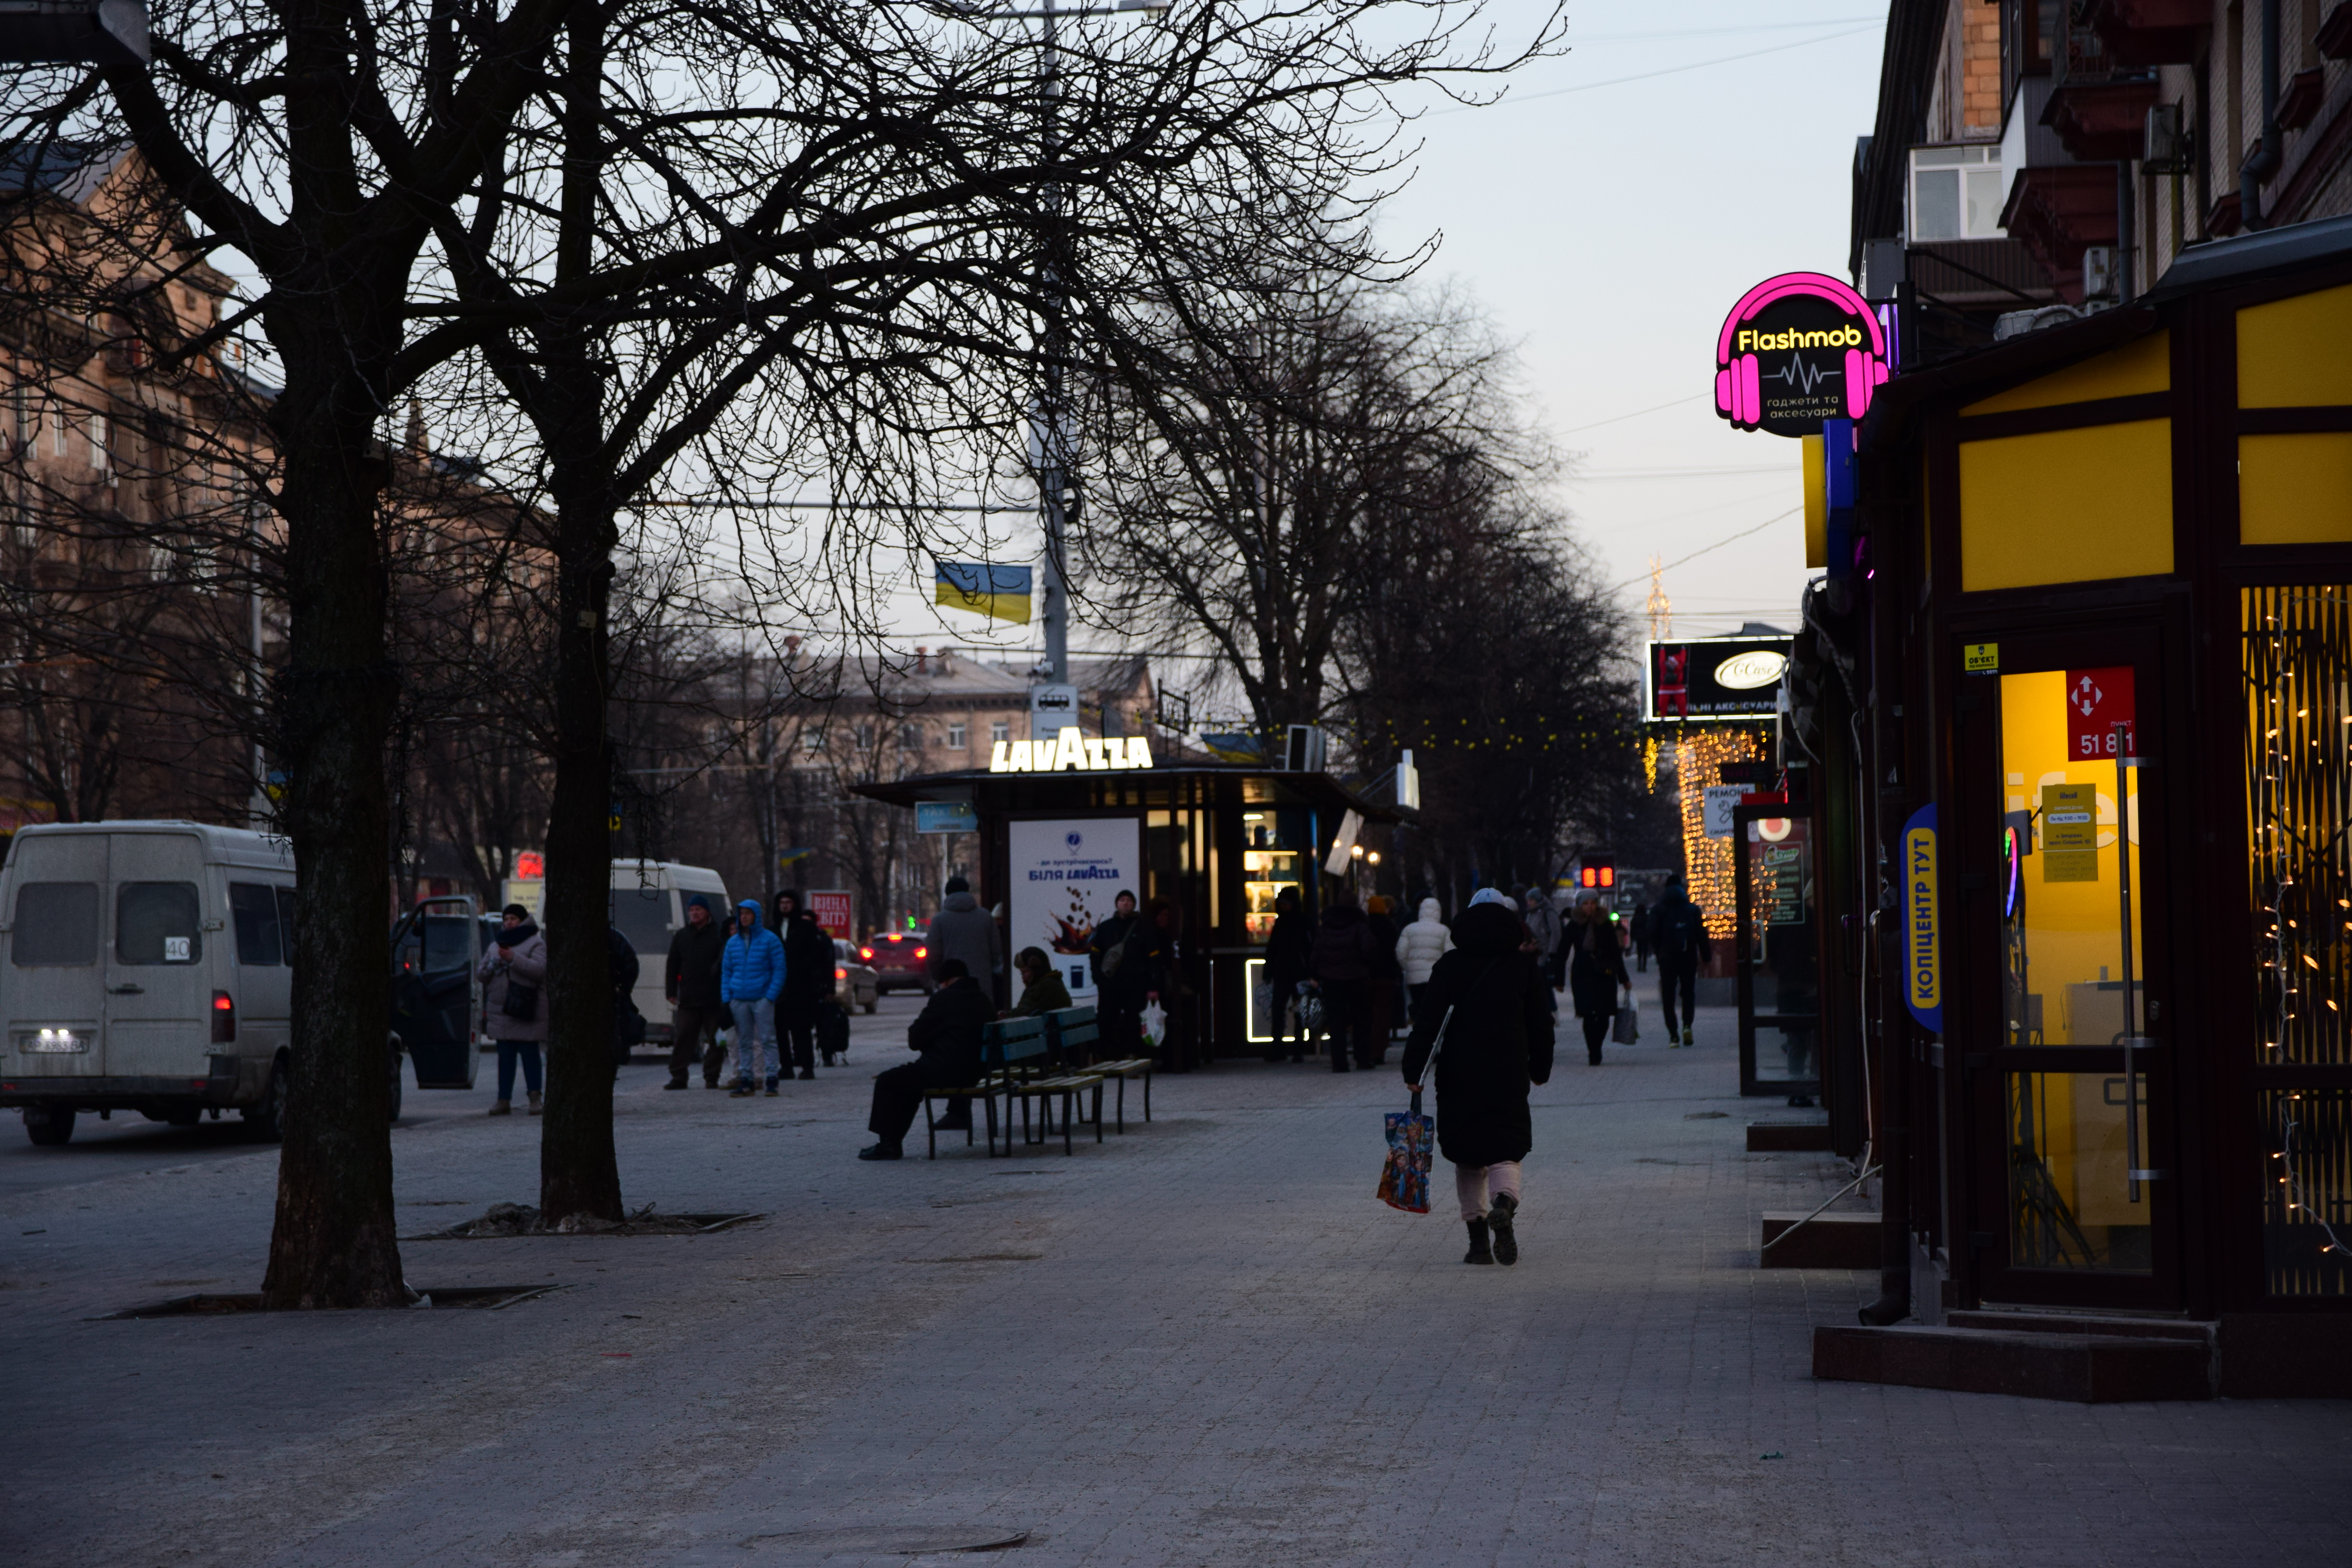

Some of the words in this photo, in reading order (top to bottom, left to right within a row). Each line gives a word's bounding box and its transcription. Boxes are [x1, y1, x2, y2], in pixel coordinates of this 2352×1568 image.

[1739, 324, 1862, 351] Flashmob
[1824, 396, 1838, 405] та
[1770, 408, 1837, 418] аксесуари
[990, 727, 1153, 772] LAVAZZA
[1914, 838, 1930, 875] ТУТ
[1029, 870, 1063, 880] БІЛЯ
[1067, 866, 1119, 879] LAVAZZA
[814, 896, 848, 910] ВИНА
[1915, 881, 1934, 998] КОПІЦЕНТР
[166, 941, 190, 956] 40
